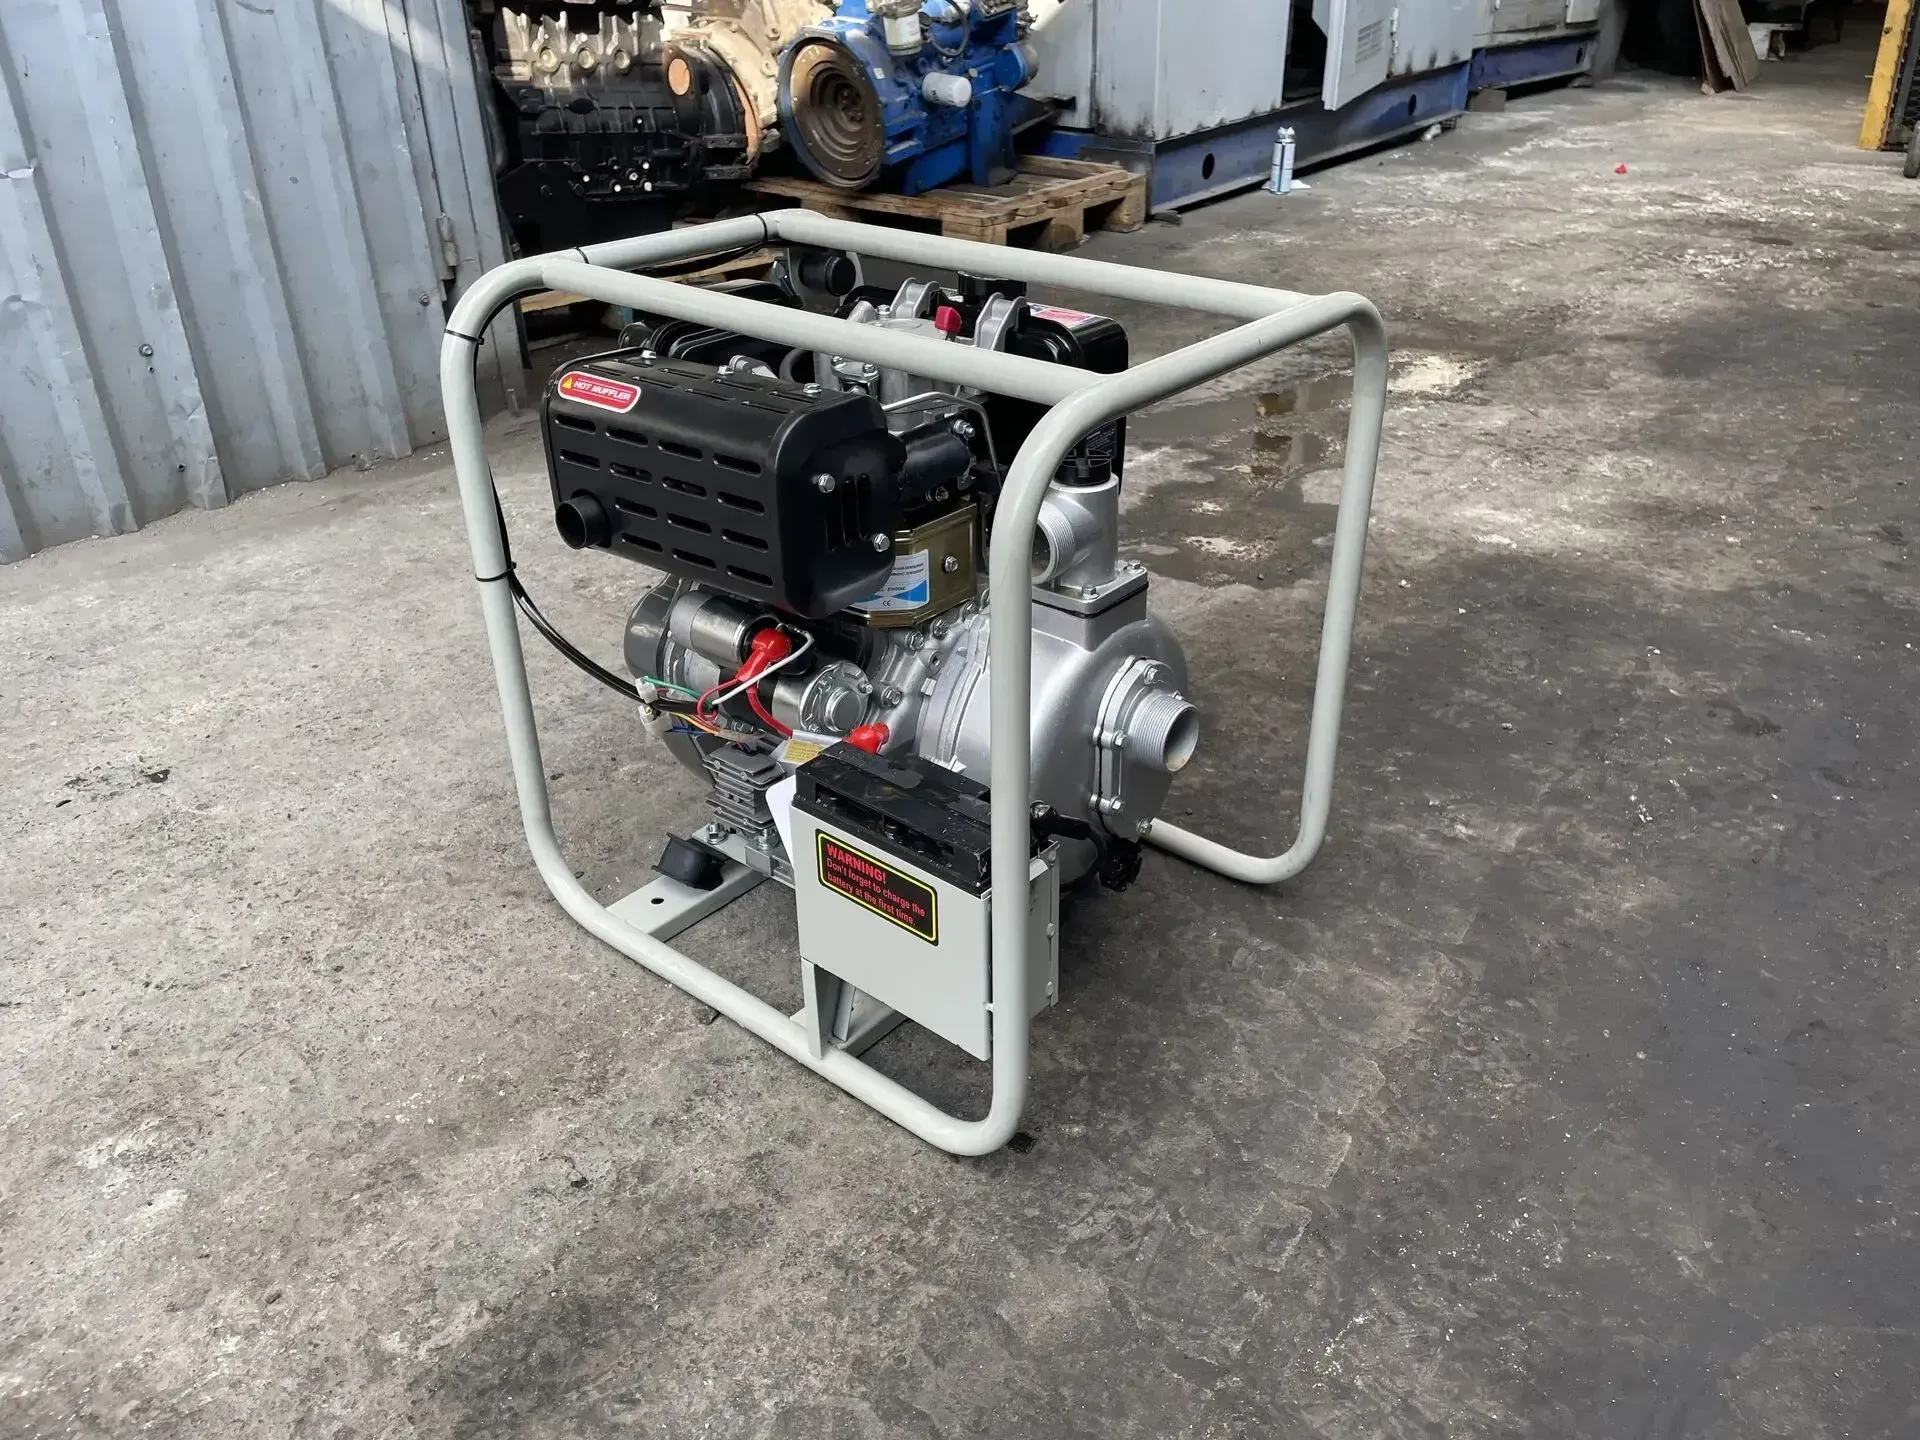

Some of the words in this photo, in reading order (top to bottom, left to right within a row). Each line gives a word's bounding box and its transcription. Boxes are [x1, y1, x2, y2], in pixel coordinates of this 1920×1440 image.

[574, 381, 592, 390] HOT
[591, 385, 632, 401] MUFFLER
[827, 843, 886, 884] WARNING!
[826, 858, 847, 875] Don't
[849, 869, 872, 889] forget
[873, 882, 882, 893] to
[882, 889, 910, 909] charge
[912, 903, 925, 917] the
[827, 872, 853, 893] battery
[855, 887, 863, 898] at
[864, 890, 877, 905] the
[878, 898, 895, 915] first
[895, 907, 916, 926] time.
